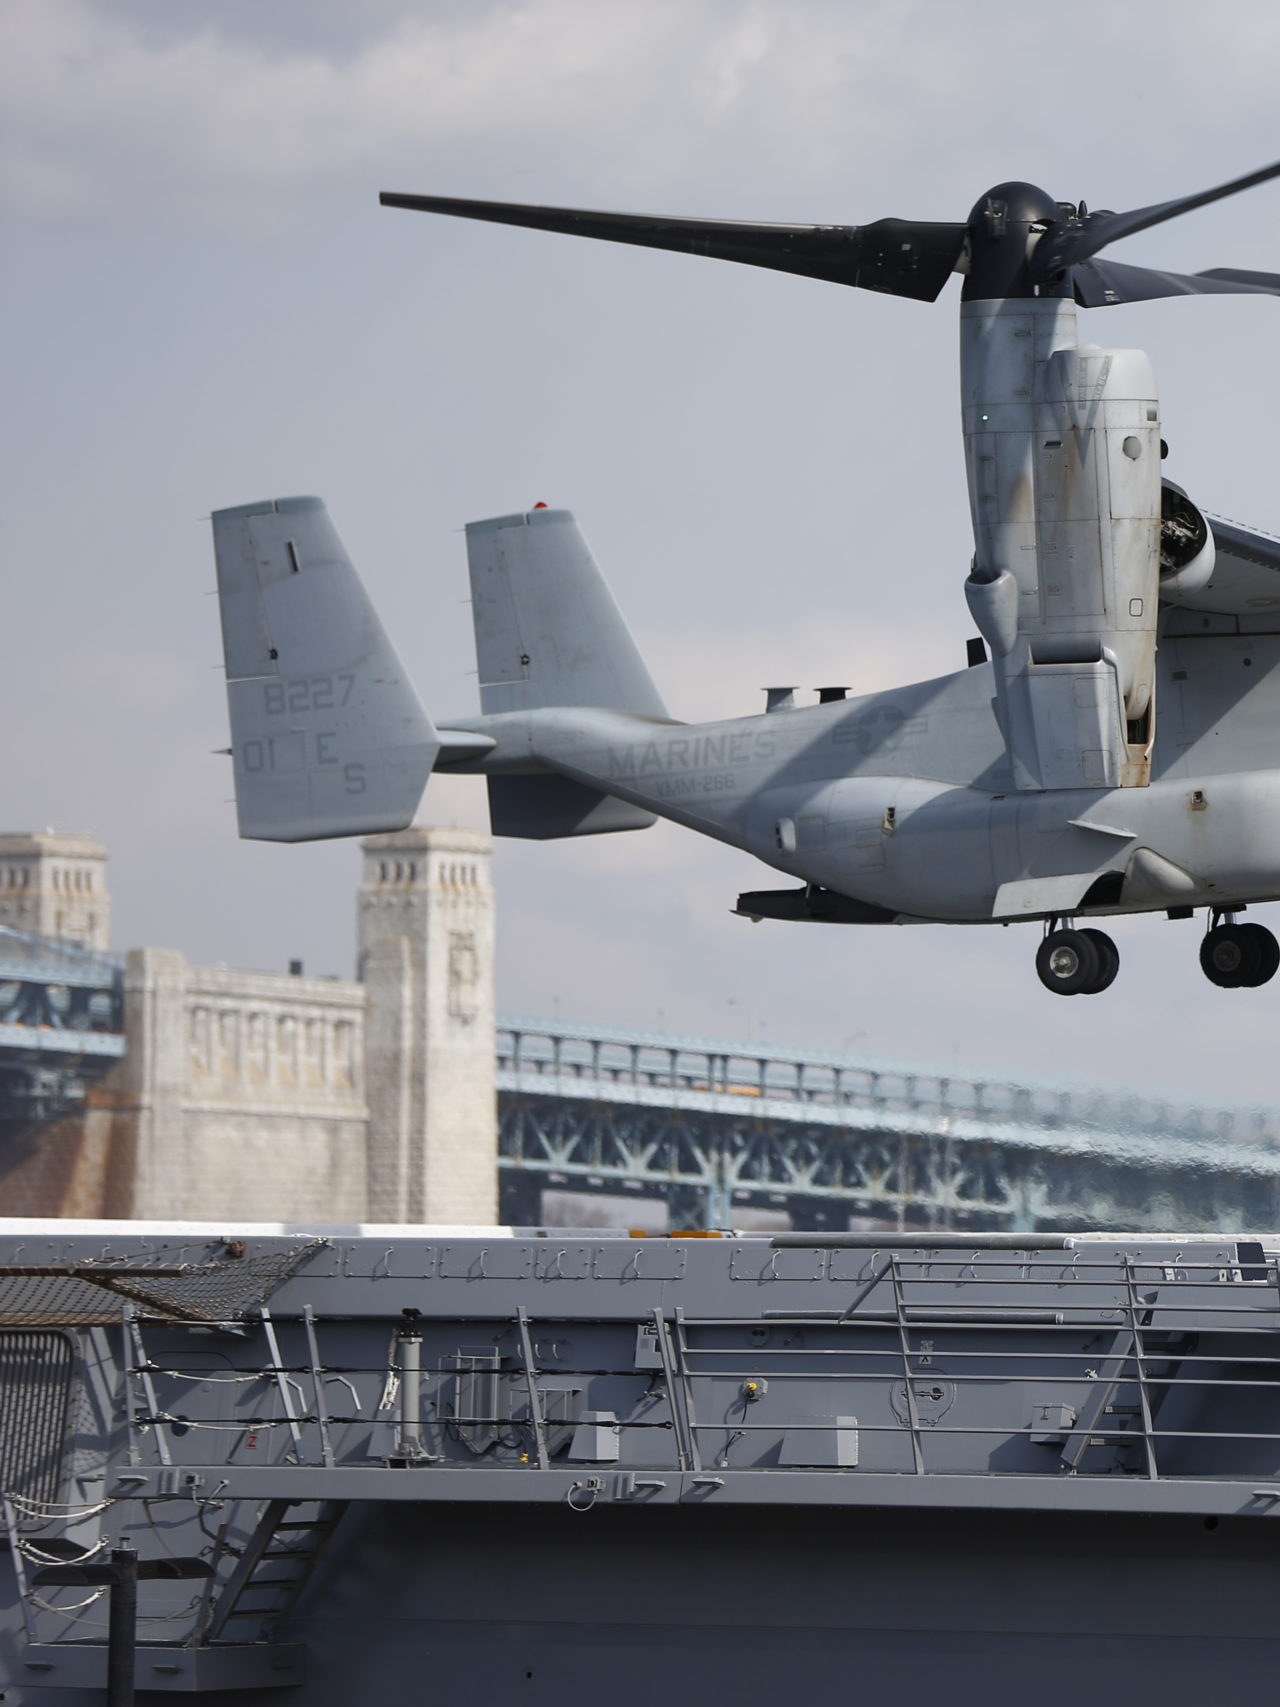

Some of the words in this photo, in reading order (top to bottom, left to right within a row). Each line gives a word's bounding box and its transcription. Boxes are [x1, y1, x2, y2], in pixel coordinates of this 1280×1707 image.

[264, 675, 355, 714] 8227
[243, 739, 274, 772] 01
[317, 732, 338, 764] E
[609, 731, 775, 777] MARINES
[345, 763, 366, 794] S
[656, 774, 734, 797] VMM-266
